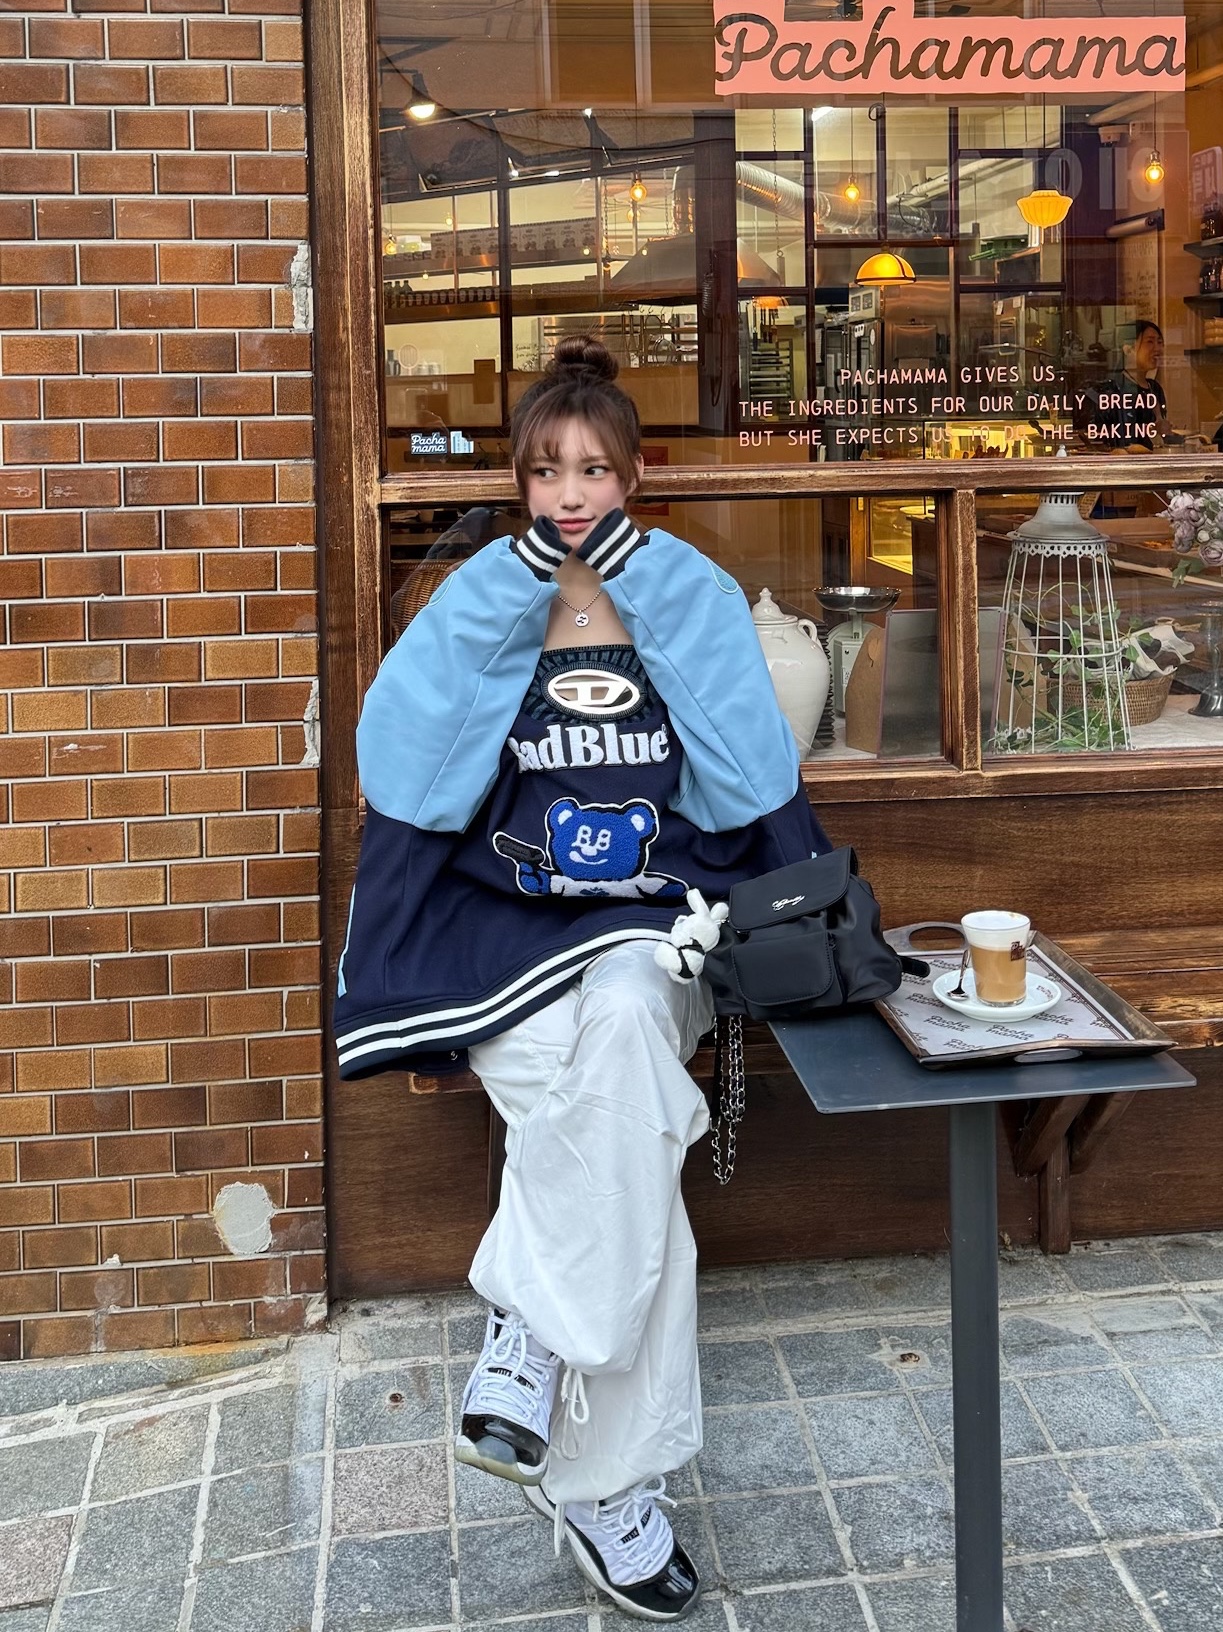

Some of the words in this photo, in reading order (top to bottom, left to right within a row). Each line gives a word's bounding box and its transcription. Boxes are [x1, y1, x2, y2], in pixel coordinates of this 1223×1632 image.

[715, 6, 1186, 82] Pachamama
[840, 368, 948, 386] PACHAMAMA
[960, 366, 1019, 383] GIVES
[1033, 366, 1065, 382] US.
[739, 401, 773, 417] THE
[788, 398, 918, 416] INGREDIENTS
[931, 397, 966, 413] FOR
[979, 396, 1014, 412] OUR
[1027, 394, 1086, 411] DAILY
[1099, 393, 1167, 410] BREAD.
[411, 434, 447, 445] Pacha
[739, 430, 774, 447] BUT
[788, 429, 822, 445] SHE
[836, 427, 918, 445] EXPECTS
[932, 426, 953, 443] US
[968, 425, 990, 442] TO
[1042, 424, 1074, 440] THE
[1087, 422, 1167, 440] BAKING.
[411, 445, 446, 453] mama
